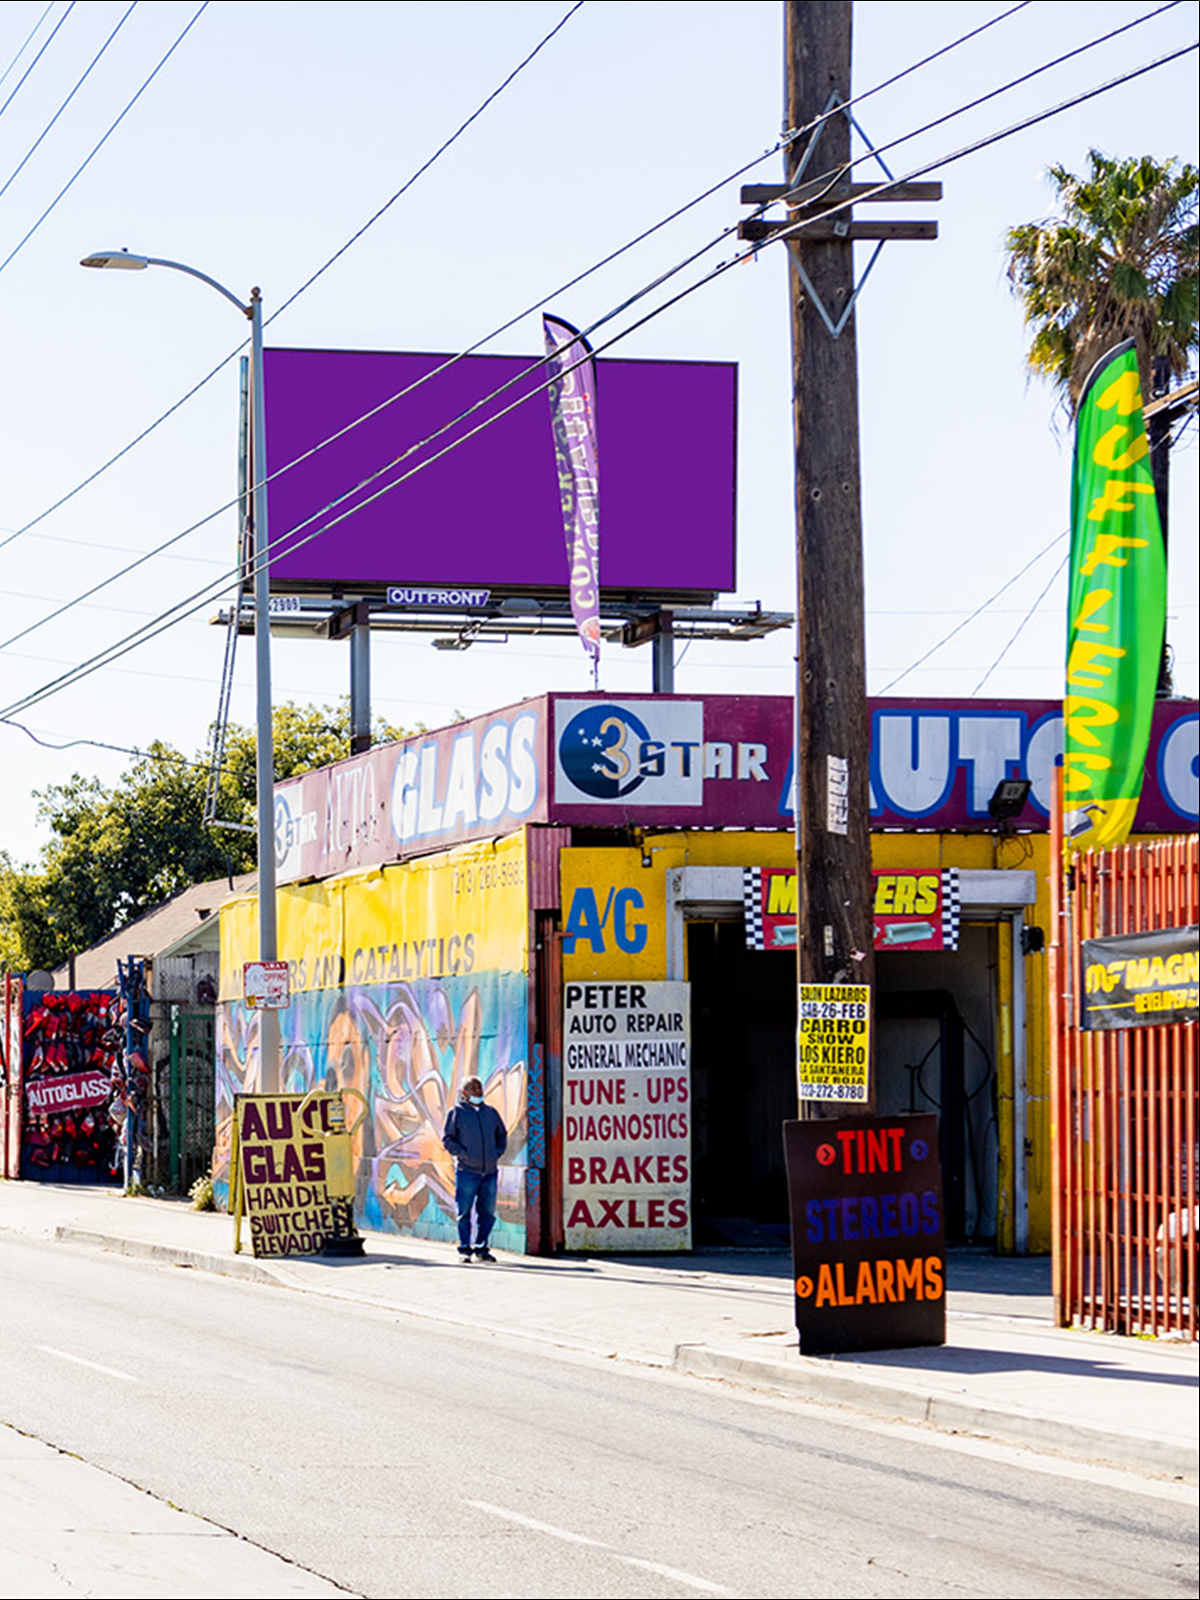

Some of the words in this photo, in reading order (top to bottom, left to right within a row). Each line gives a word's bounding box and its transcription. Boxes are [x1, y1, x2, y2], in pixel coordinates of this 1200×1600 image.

[391, 589, 484, 605] OUTFRONT
[599, 716, 630, 780] 3
[638, 740, 770, 782] STAR
[322, 761, 376, 856] AUTO
[391, 710, 539, 844] GLASS
[767, 874, 940, 915] MERS
[562, 885, 648, 955] A/C
[353, 934, 475, 985] CATALYTICS
[566, 985, 647, 1009] PETER
[569, 1014, 616, 1033] AUTO
[627, 1013, 684, 1032] REPAIR
[800, 1019, 866, 1035] CARRO
[807, 1034, 855, 1044] SHOW
[567, 1045, 622, 1069] GENERAL
[625, 1041, 687, 1068] MECHANIC
[822, 1046, 866, 1065] KIERO
[29, 1078, 110, 1107] AUTOGLASS
[567, 1079, 626, 1105] TUNE
[647, 1077, 688, 1103] UPS
[811, 1076, 830, 1084] LUZ
[566, 1113, 688, 1141] DIAGNOSTICS
[837, 1127, 905, 1174] TINT
[568, 1155, 688, 1185] BRAKES
[247, 1184, 346, 1211] HANDL
[567, 1199, 688, 1228] AXLES
[806, 1191, 940, 1243] STEREOS
[815, 1256, 944, 1308] ALARMS
